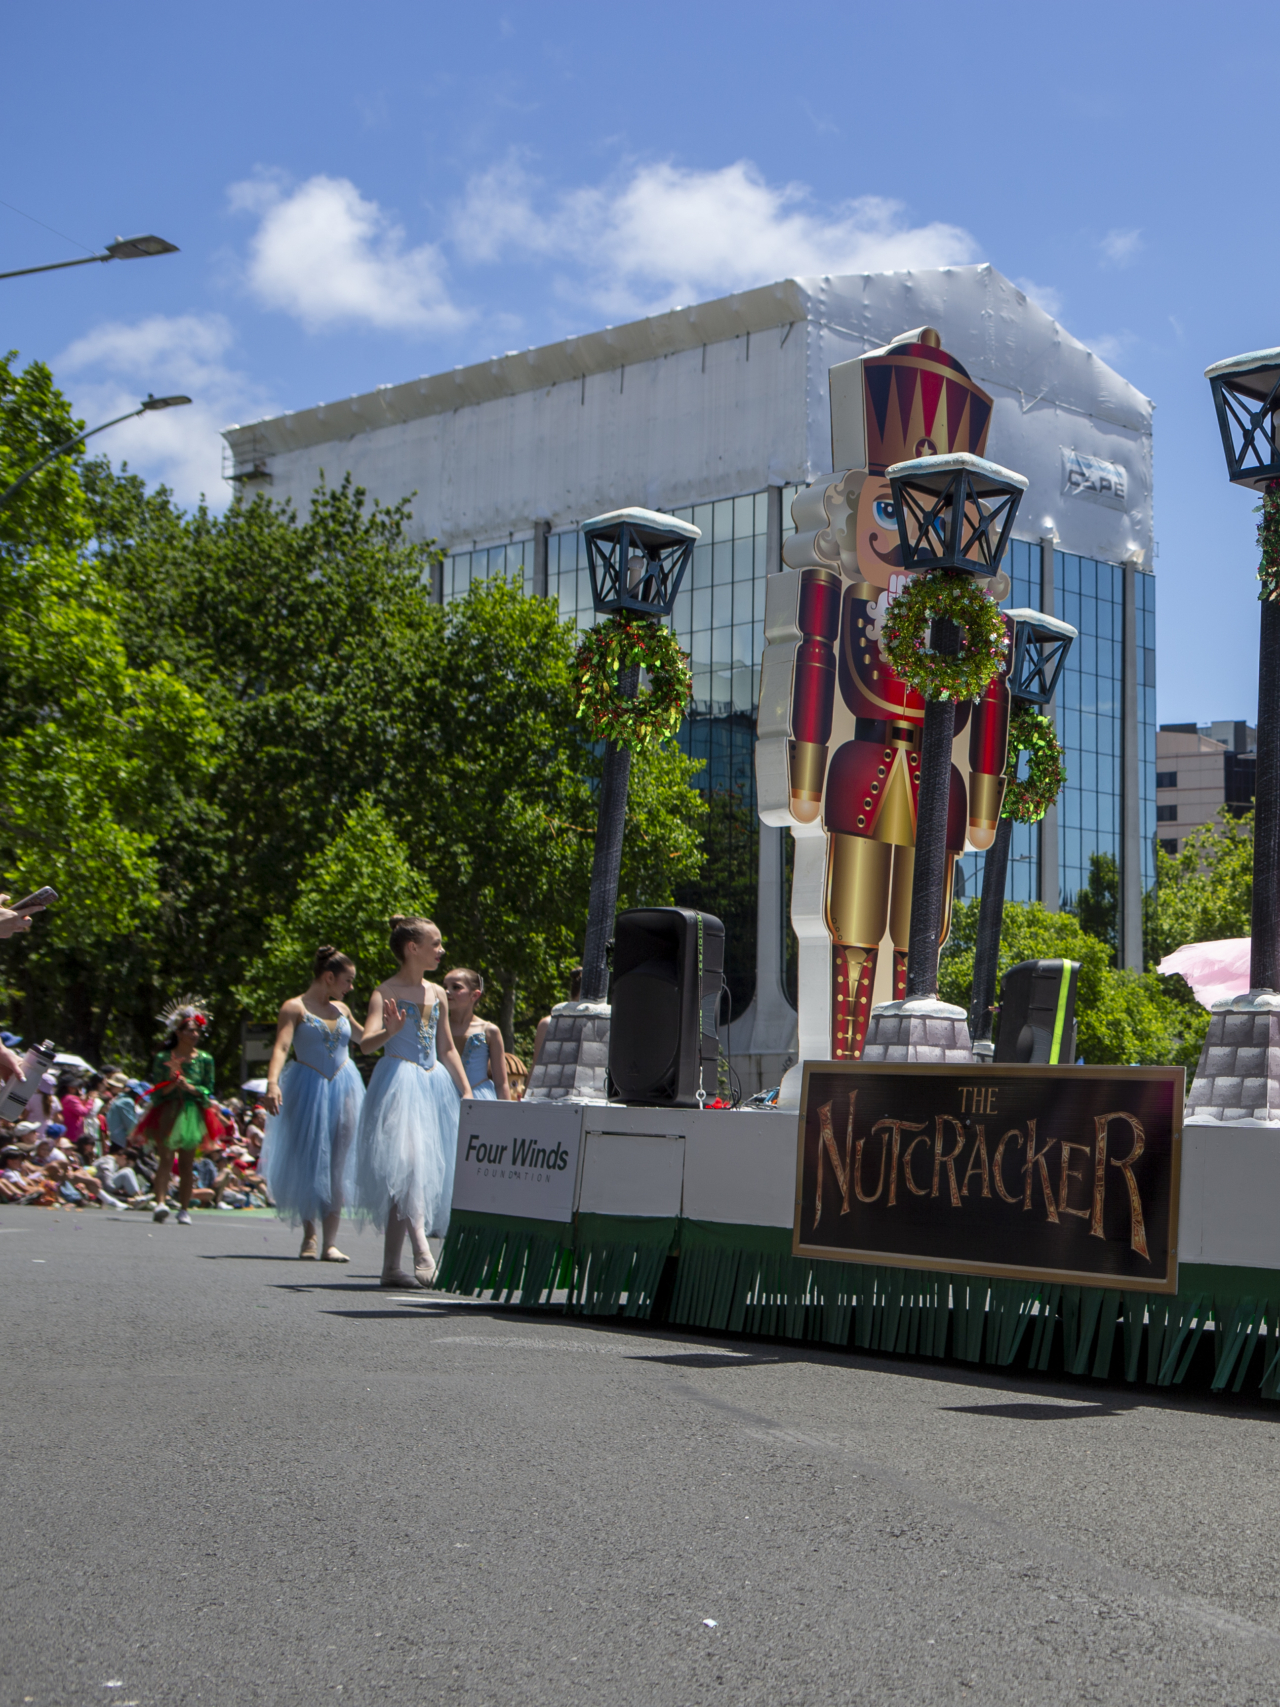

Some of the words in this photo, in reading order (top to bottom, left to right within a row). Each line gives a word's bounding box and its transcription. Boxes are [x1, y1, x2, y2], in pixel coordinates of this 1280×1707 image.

[1068, 469, 1125, 499] CAPE
[958, 1087, 998, 1114] THE
[465, 1134, 508, 1165] Four
[511, 1138, 569, 1171] Winds
[476, 1168, 551, 1183] FOUNDATION
